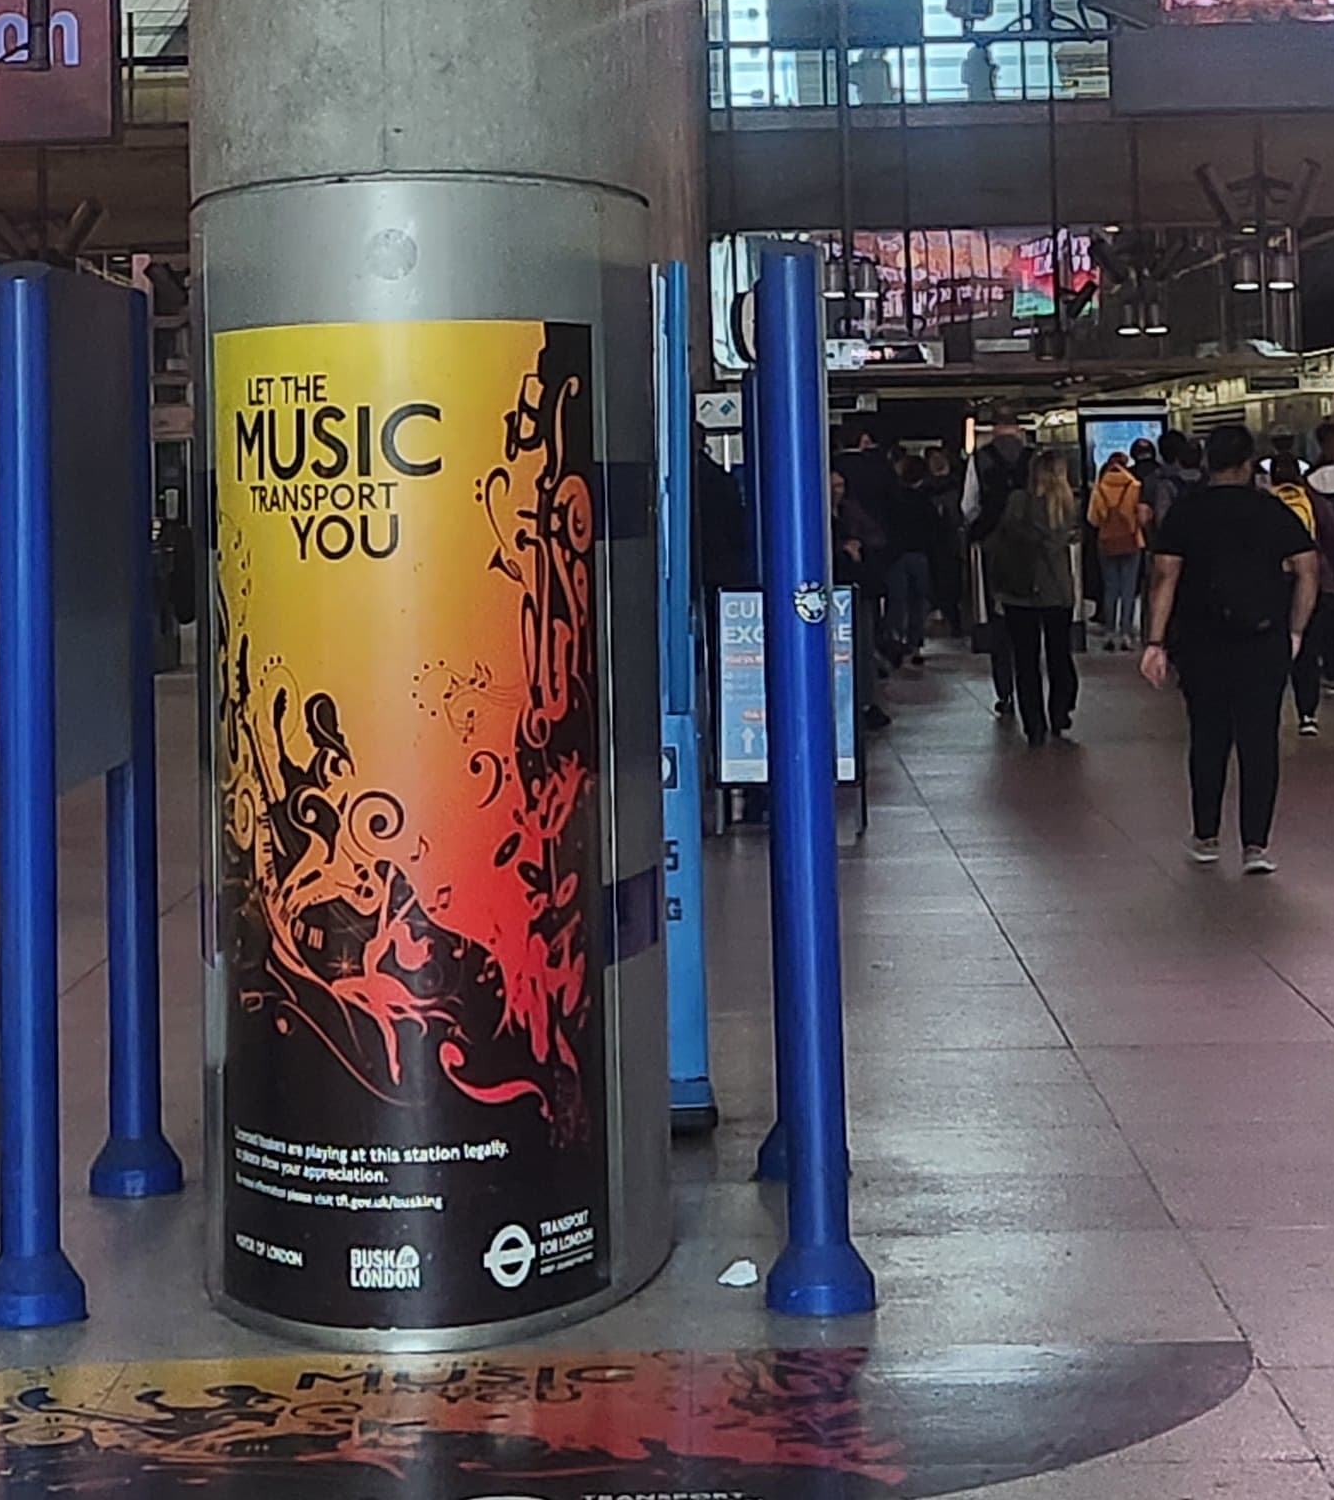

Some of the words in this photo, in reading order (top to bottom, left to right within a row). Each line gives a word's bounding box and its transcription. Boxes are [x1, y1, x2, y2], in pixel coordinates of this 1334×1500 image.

[247, 377, 275, 406] LET
[280, 374, 327, 404] THE
[234, 402, 442, 482] MUSIC
[250, 482, 399, 514] TRANSPORT
[291, 513, 400, 561] YOU
[305, 1144, 348, 1165] playing
[350, 1148, 367, 1163] at
[369, 1146, 401, 1164] this
[403, 1144, 460, 1163] station
[463, 1138, 510, 1161] legally.
[302, 1165, 389, 1184] appreciation.
[539, 1209, 590, 1237] TRANSPORT
[266, 1243, 304, 1268] LONDON
[539, 1239, 558, 1256] FOR
[559, 1227, 595, 1251] LONDON
[350, 1248, 397, 1269] BUSK
[350, 1267, 421, 1289] LONDON
[295, 1364, 637, 1394] MUSIC
